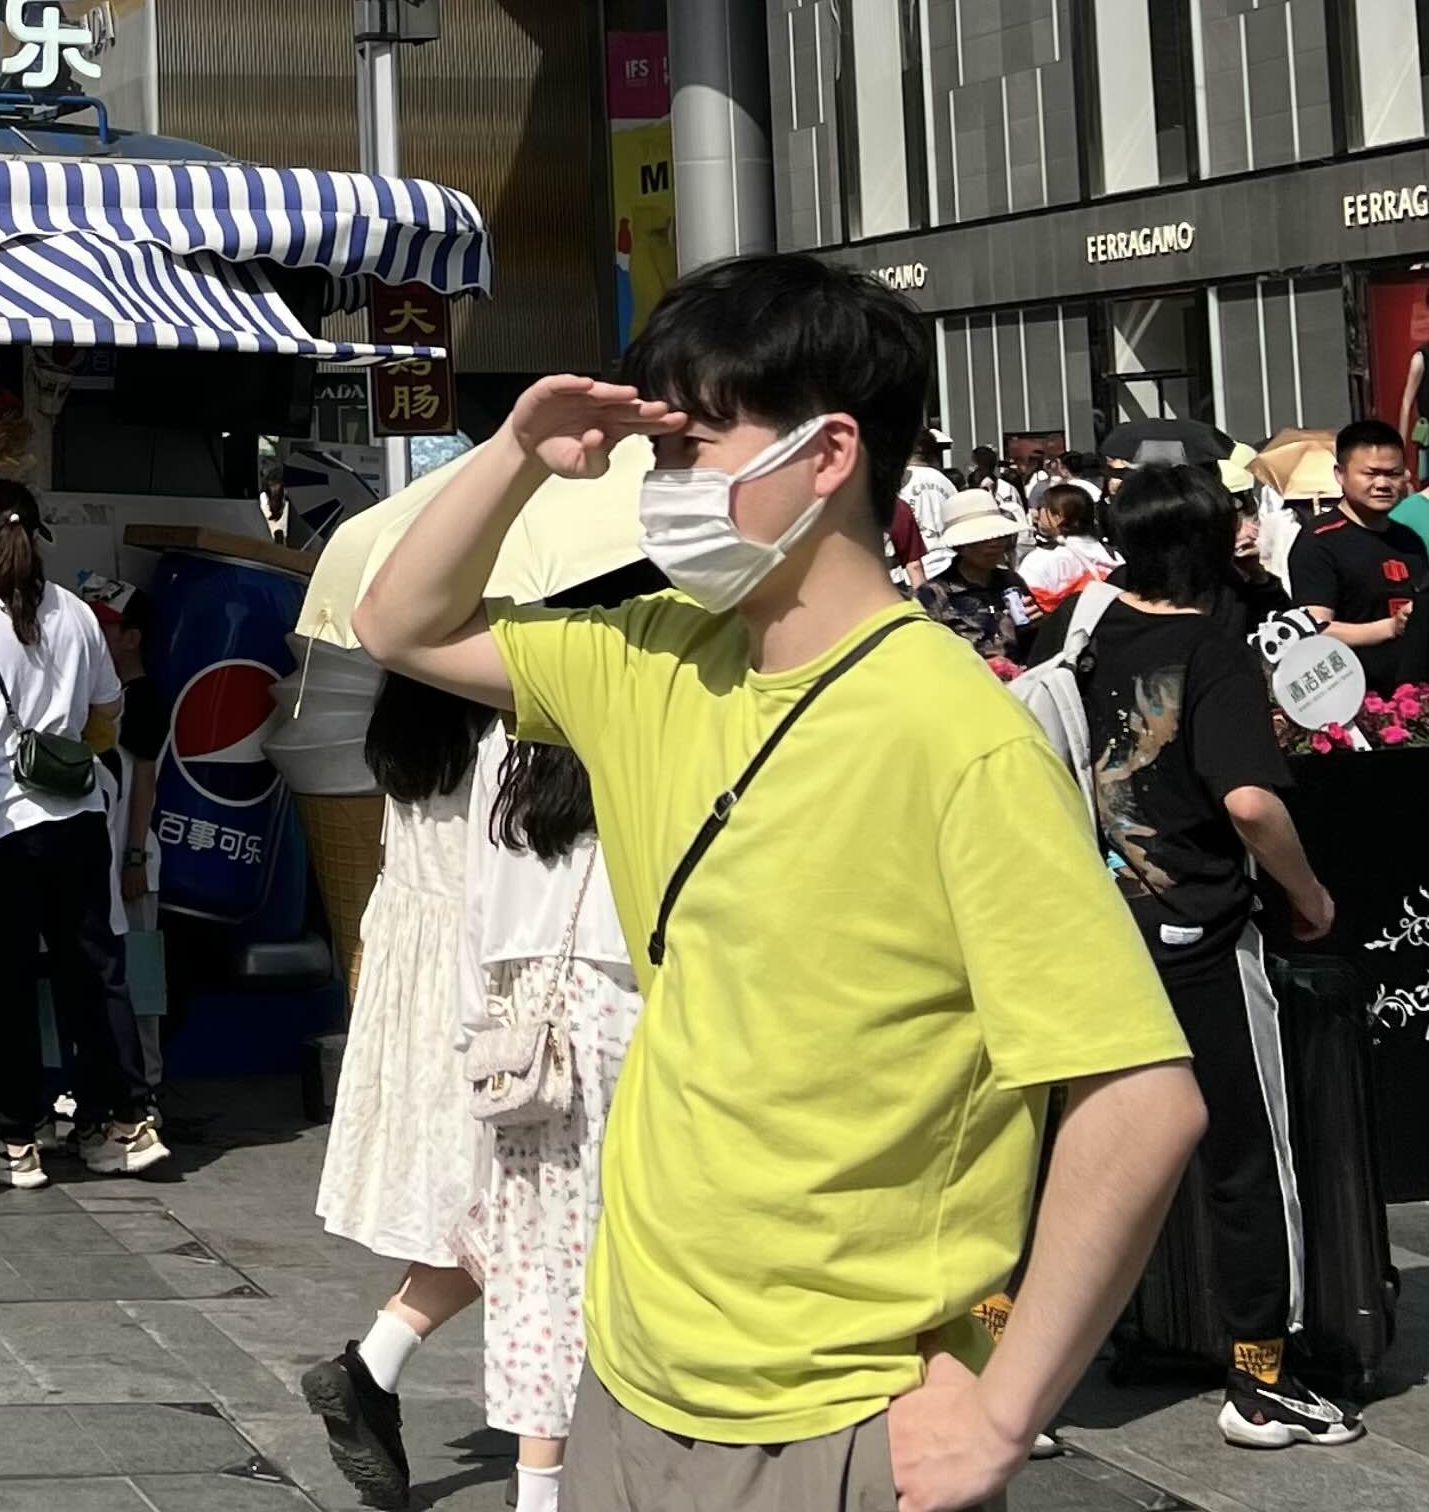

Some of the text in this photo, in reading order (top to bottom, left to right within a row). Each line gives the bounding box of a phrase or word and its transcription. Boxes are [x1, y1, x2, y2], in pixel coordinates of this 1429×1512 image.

[625, 58, 650, 80] IFS
[1343, 184, 1429, 228] FERRAG
[1086, 221, 1195, 264] FERRAGAMO
[314, 383, 366, 400] ADA
[158, 810, 263, 866] 百事可乐
